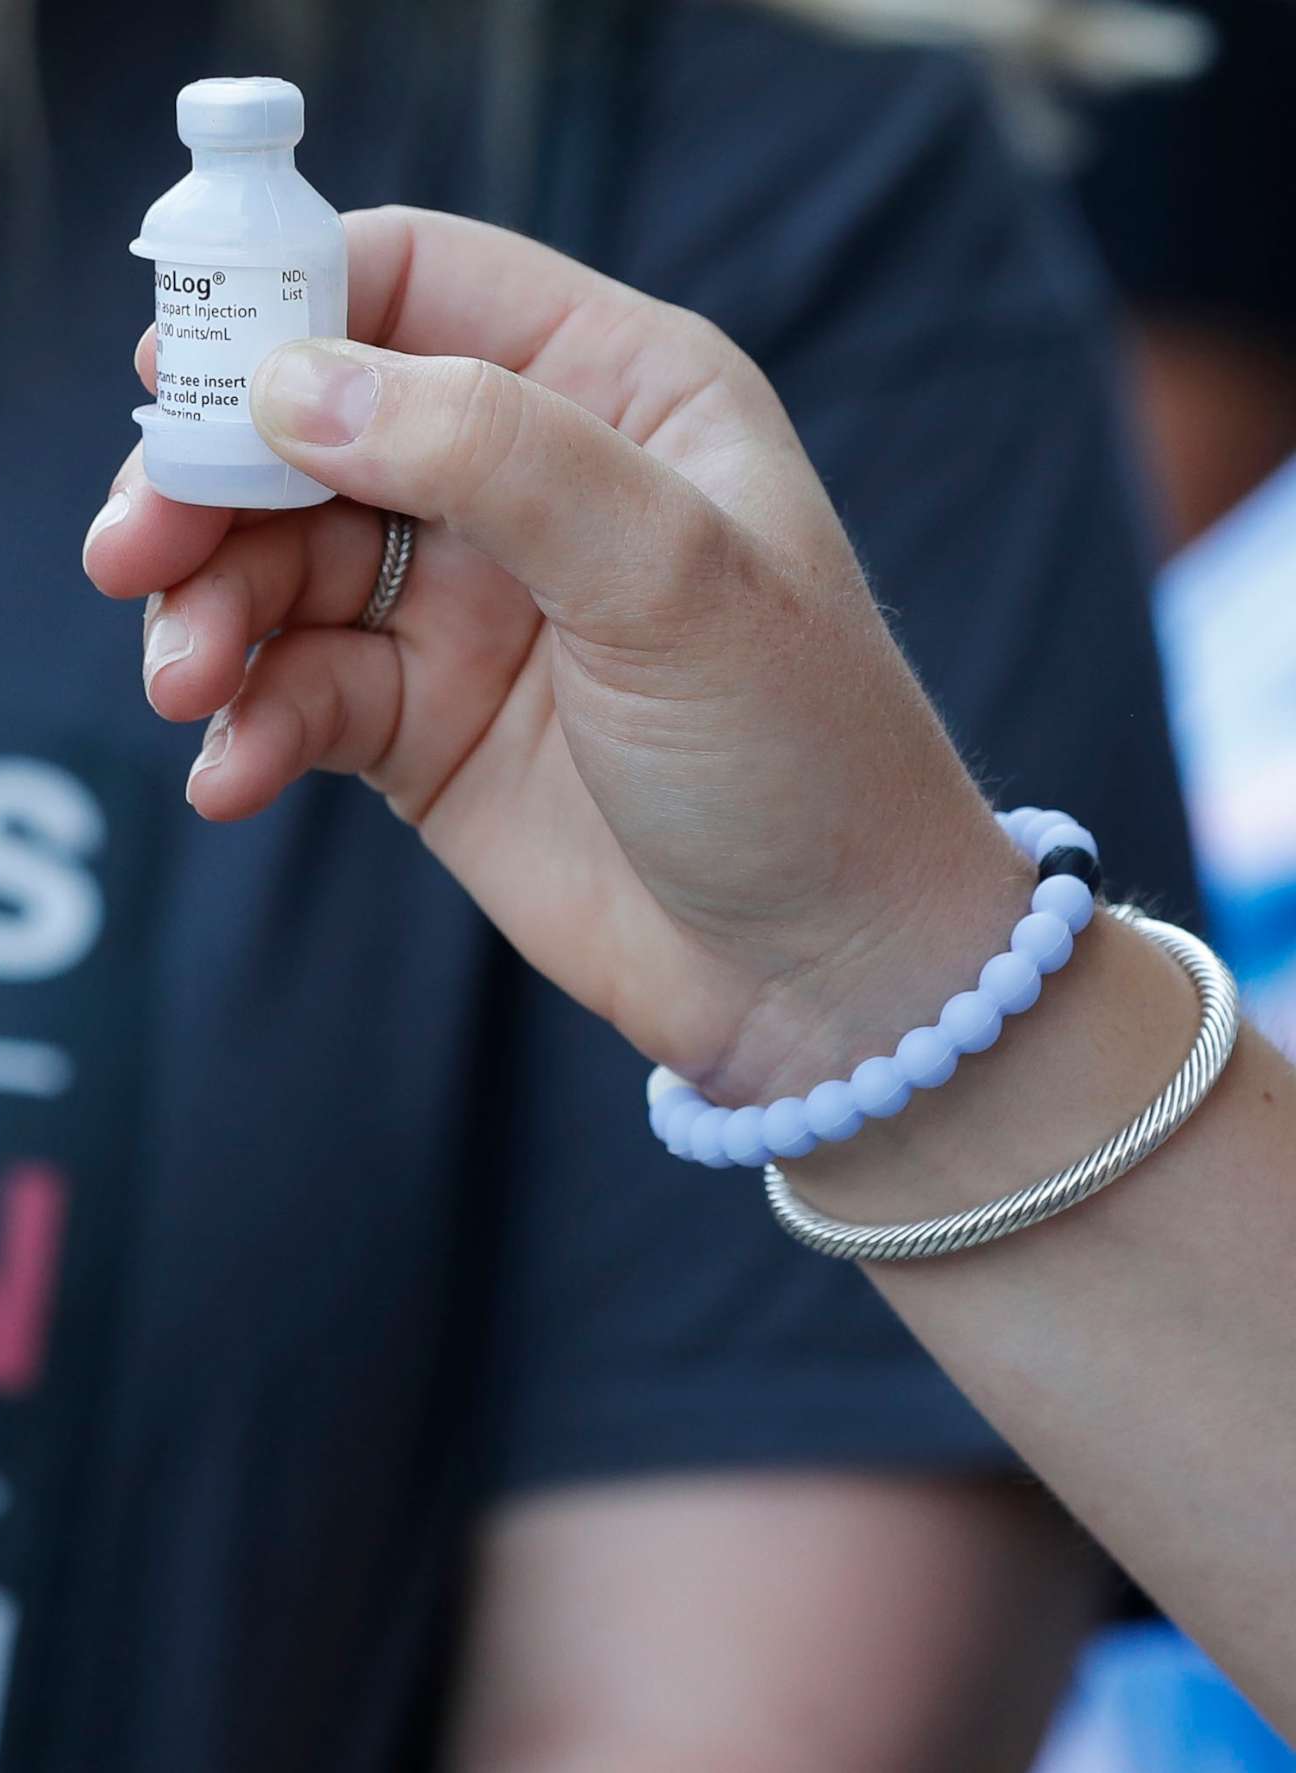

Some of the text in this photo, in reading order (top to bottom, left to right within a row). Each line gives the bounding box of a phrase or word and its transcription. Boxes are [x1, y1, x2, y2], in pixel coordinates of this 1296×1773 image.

[282, 288, 303, 301] List
[162, 302, 191, 317] aspart
[195, 303, 257, 321] Injection
[161, 322, 174, 337] 100
[177, 326, 232, 341] units/mL
[180, 375, 200, 387] see
[204, 374, 246, 389] insert
[167, 391, 172, 401] a
[174, 391, 197, 404] cold
[201, 392, 239, 408] place
